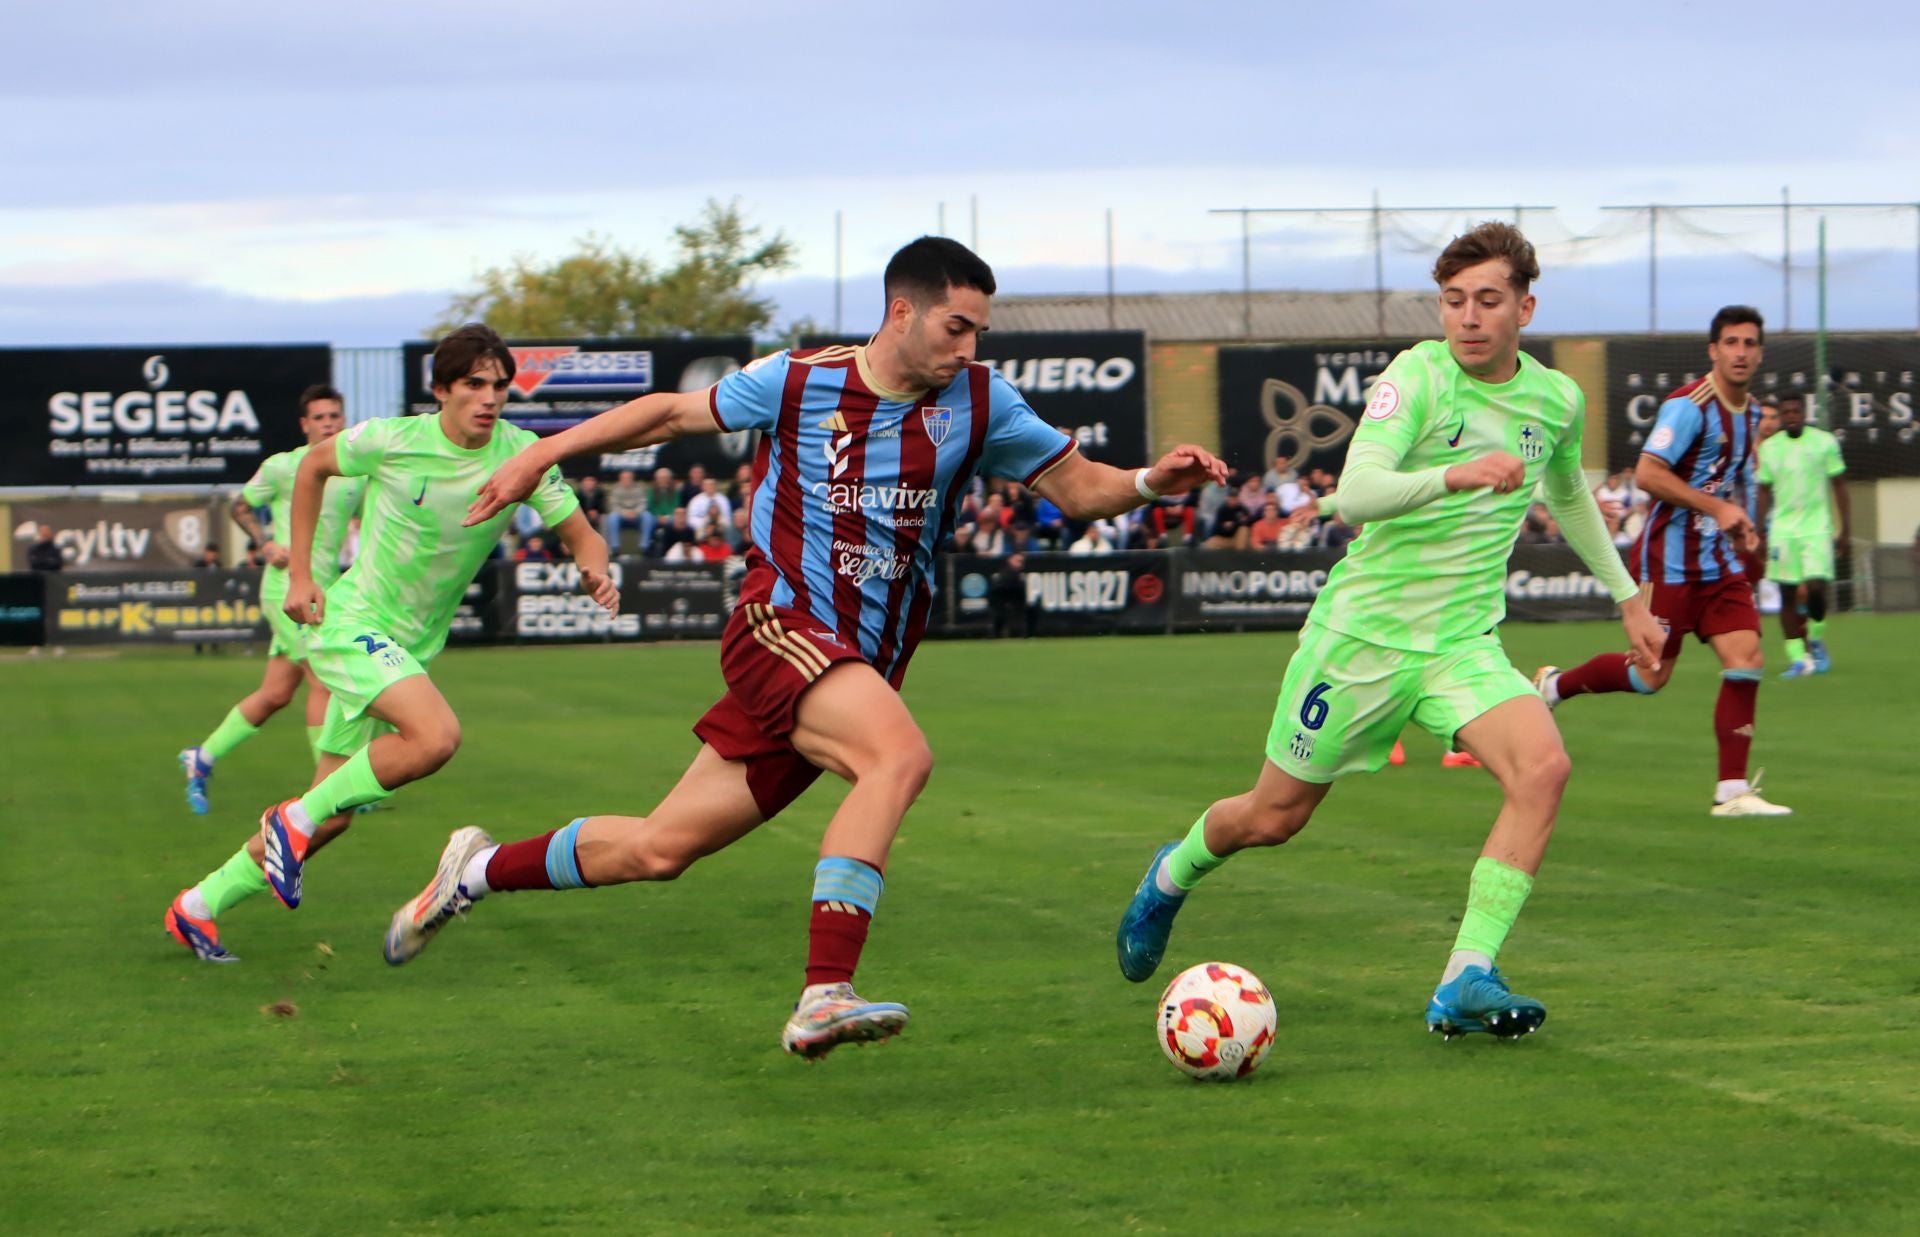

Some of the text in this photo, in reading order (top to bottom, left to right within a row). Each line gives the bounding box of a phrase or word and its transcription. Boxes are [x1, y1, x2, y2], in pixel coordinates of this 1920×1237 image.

[981, 357, 1135, 391] UERO
[1627, 371, 1914, 388] RESURANTE
[49, 389, 260, 434] SEGESA
[812, 477, 938, 511] cajaviva
[178, 514, 201, 551] 8
[877, 516, 928, 528] Fundació
[1182, 570, 1328, 597] INNOPORC
[518, 591, 613, 614] BAÑO
[518, 613, 641, 638] COCINAS
[1300, 681, 1333, 731] 6
